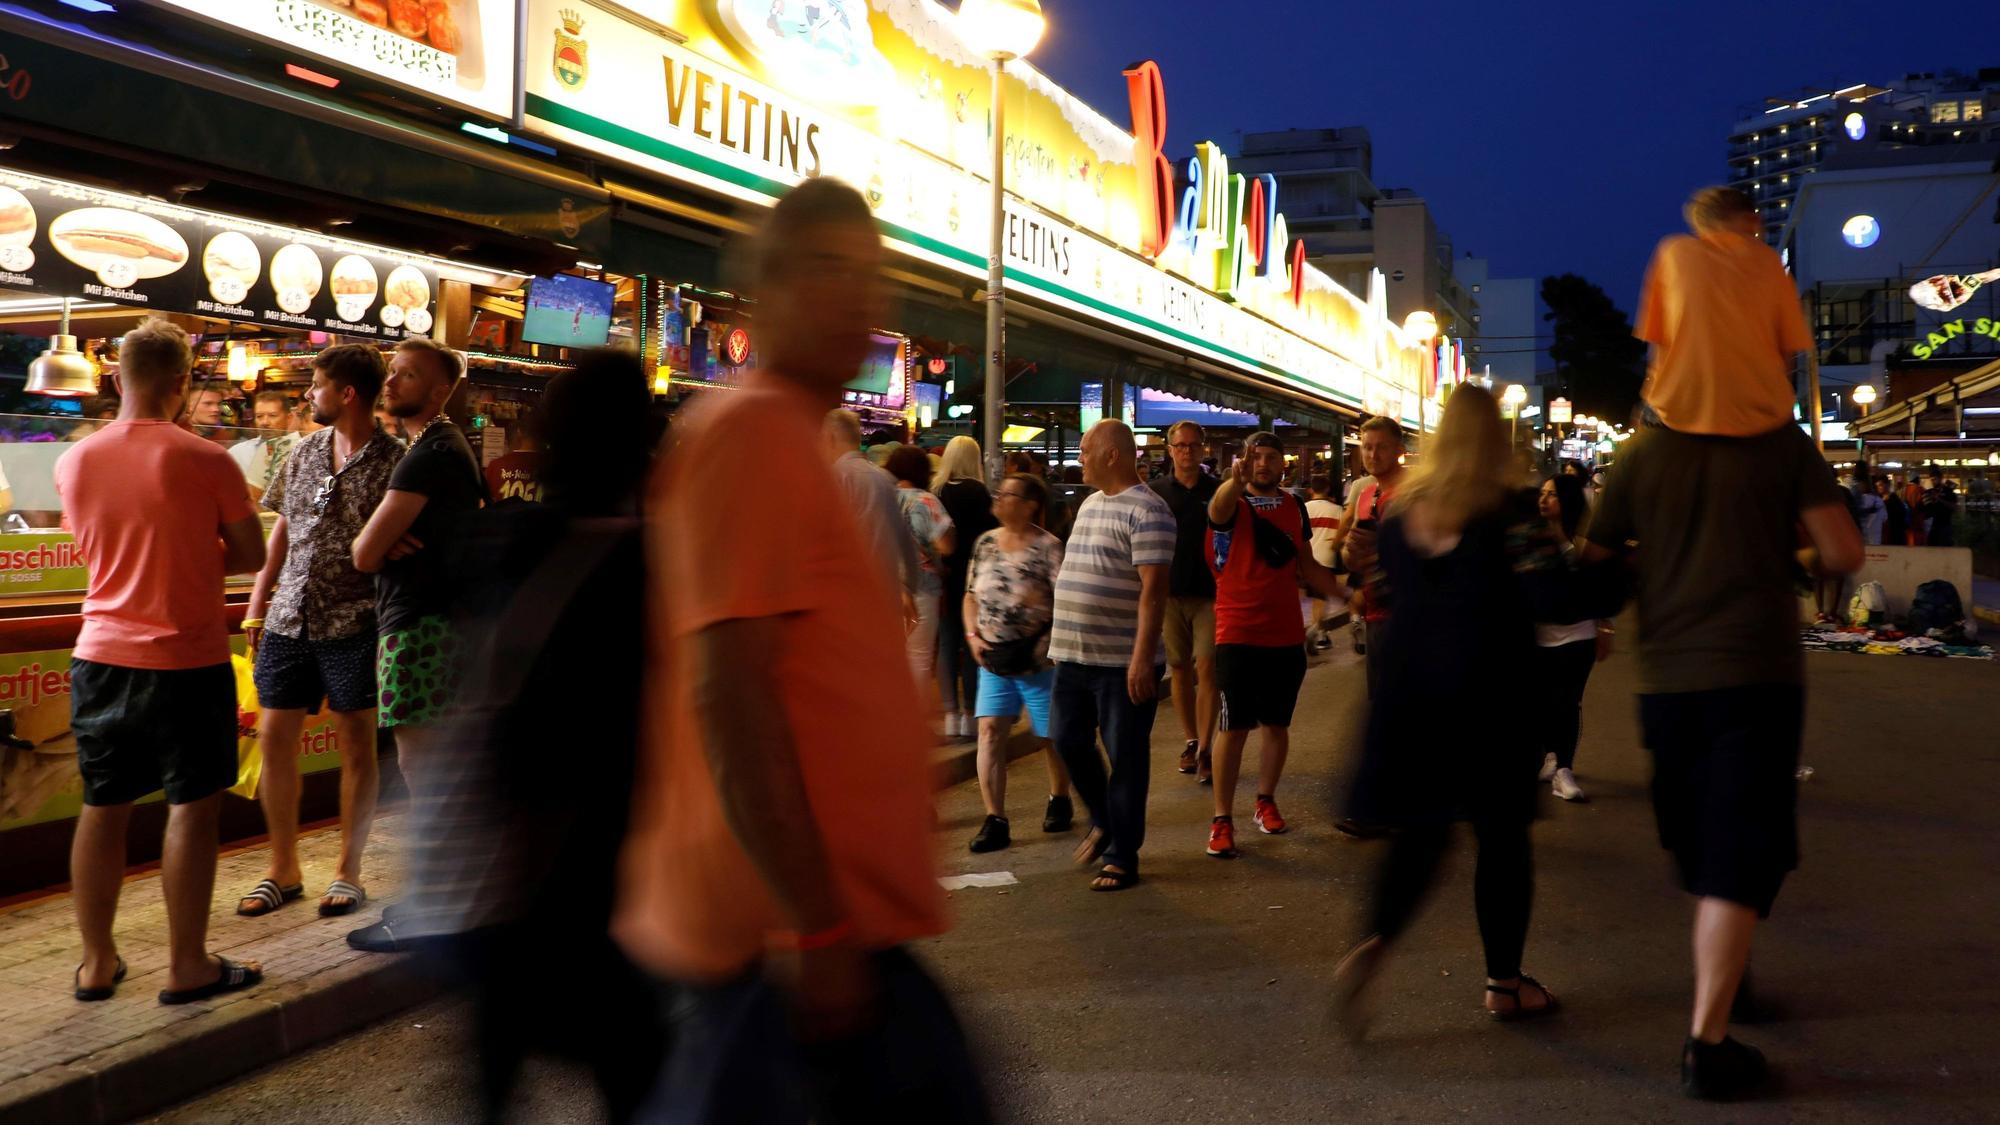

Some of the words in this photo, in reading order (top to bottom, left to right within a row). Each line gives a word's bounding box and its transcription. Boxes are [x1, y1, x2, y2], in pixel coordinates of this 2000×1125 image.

[662, 54, 821, 179] VELTINS
[84, 283, 102, 296] Mit
[104, 285, 148, 302] Brötchen
[197, 300, 213, 312] Mit
[213, 302, 255, 317] Brötchen
[264, 309, 280, 321] Mit
[280, 311, 317, 325] Brötchen
[1911, 318, 1966, 360] SAN
[1973, 317, 2000, 342] SI
[0, 542, 87, 571] aschlik
[10, 572, 42, 583] SOSSE
